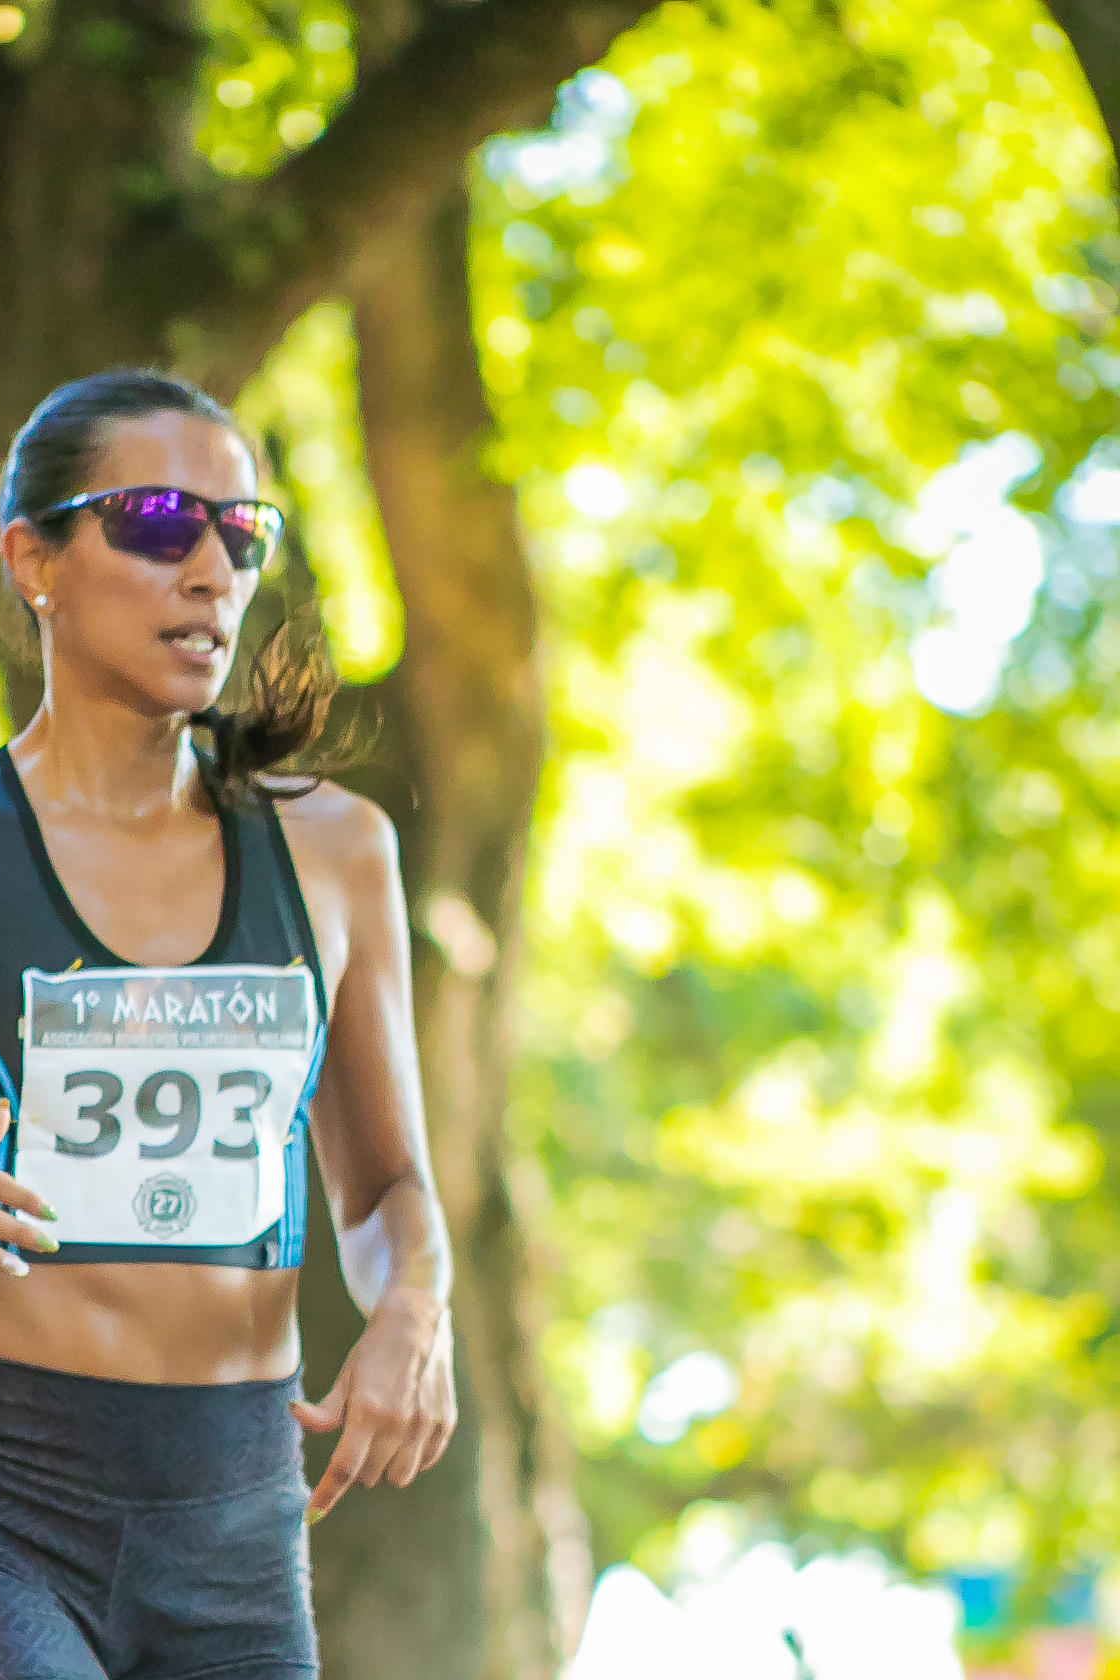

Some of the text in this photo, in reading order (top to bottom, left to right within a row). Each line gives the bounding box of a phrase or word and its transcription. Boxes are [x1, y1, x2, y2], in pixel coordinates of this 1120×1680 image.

[112, 981, 278, 1025] MARATÓN
[54, 1069, 272, 1160] 393
[152, 1192, 179, 1215] 27
